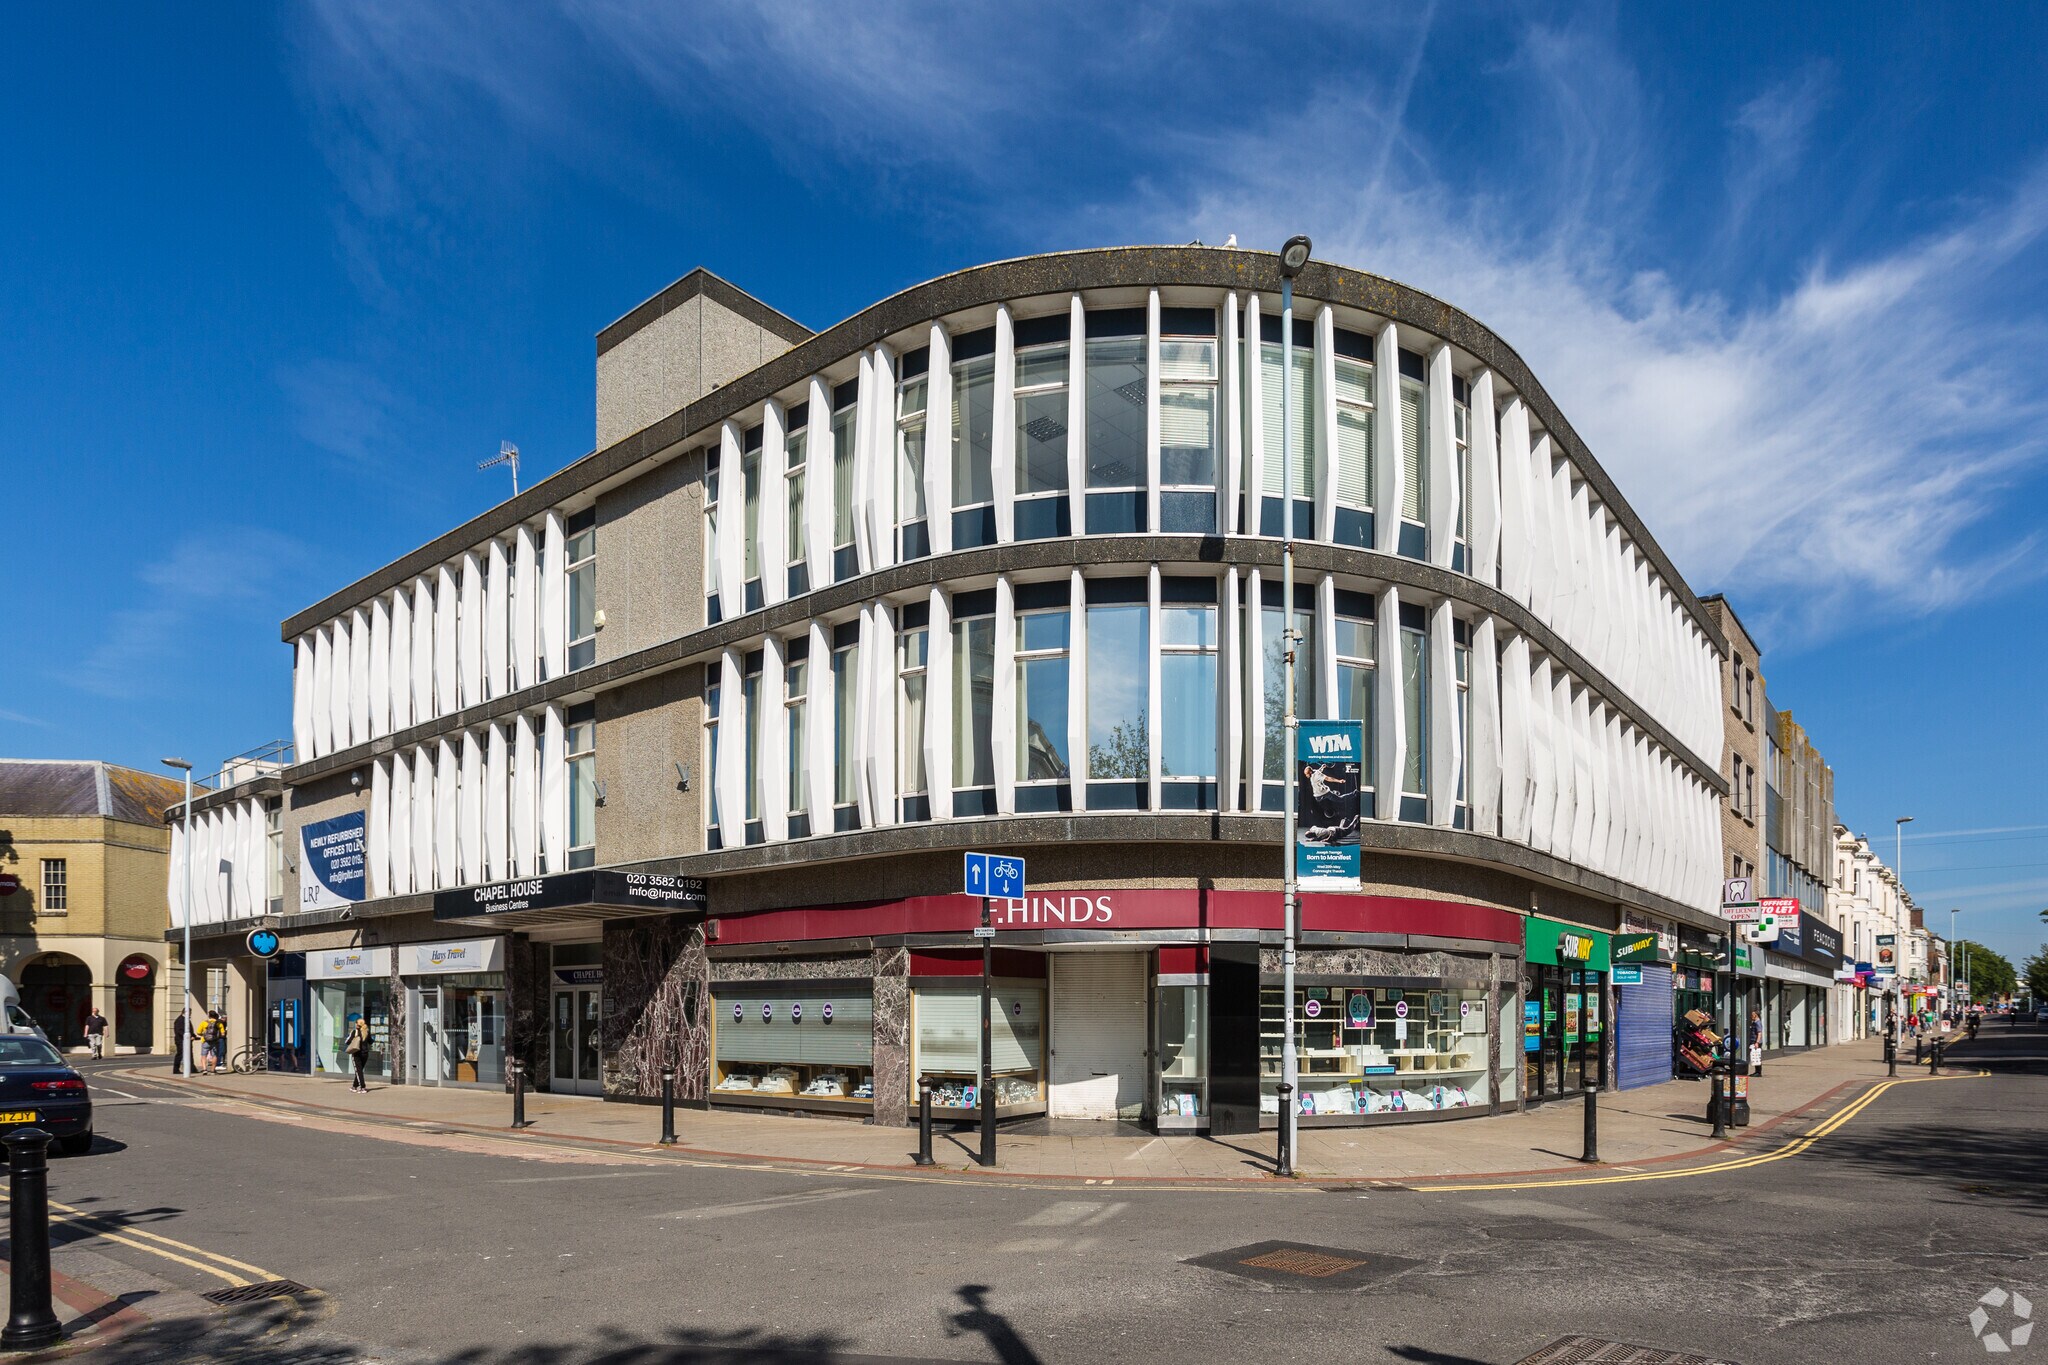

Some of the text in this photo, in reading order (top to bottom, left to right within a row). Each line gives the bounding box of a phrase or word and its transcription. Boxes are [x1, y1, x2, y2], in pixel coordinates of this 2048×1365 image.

[1309, 734, 1352, 753] WTM
[310, 827, 363, 848] NEWLY REFURBISHED
[323, 845, 345, 858] OFFICES
[346, 843, 353, 853] TO
[331, 859, 339, 870] 020
[340, 857, 352, 868] 3582
[626, 874, 647, 885] 020
[649, 875, 675, 887] 3582
[677, 878, 703, 889] 0192
[304, 885, 320, 904] LRP
[474, 879, 543, 902] CHAPEL HOUSE
[629, 886, 706, 902] info@lrpltd.com
[485, 900, 529, 913] Business Centres
[1761, 906, 1795, 914] TO LET
[1813, 928, 1836, 950] PEACOCKS
[431, 948, 466, 961] Hays Travel
[1562, 934, 1594, 960] SUBWAY
[1616, 936, 1654, 958] SUBWAY
[334, 955, 361, 966] Hays Travel
[573, 970, 596, 979] CHAPEL
[9, 1112, 31, 1121] ZJY
